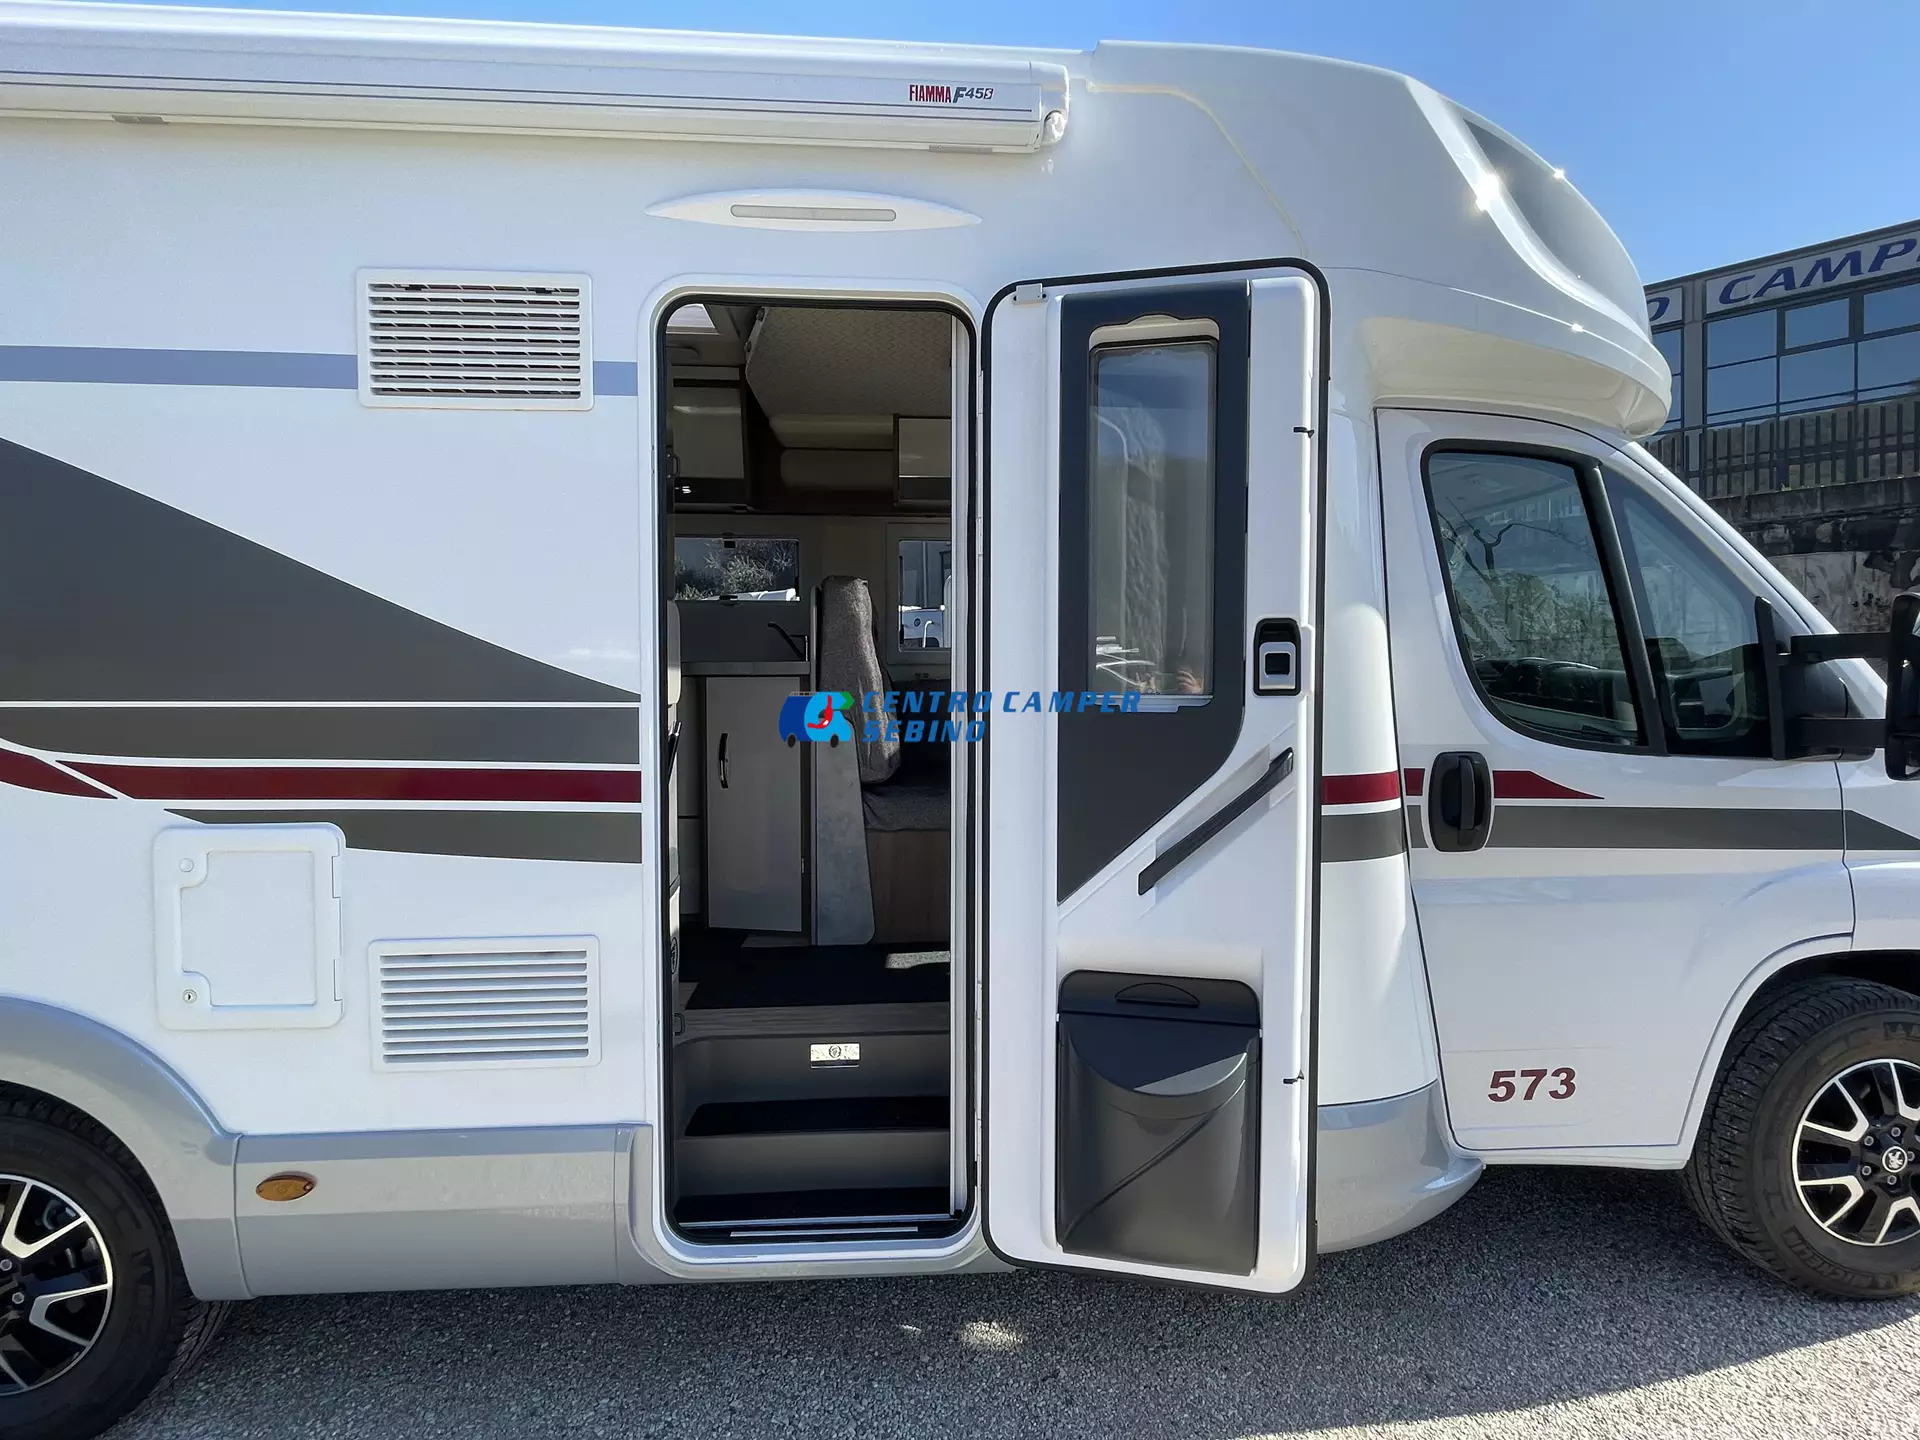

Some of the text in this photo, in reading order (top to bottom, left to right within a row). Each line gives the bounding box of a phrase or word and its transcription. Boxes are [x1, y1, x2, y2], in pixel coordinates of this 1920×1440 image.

[909, 84, 952, 103] FIAMMA
[1718, 238, 1920, 305] CAMP
[1487, 1067, 1577, 1102] 573
[1782, 1231, 1873, 1289] MICHELIN
